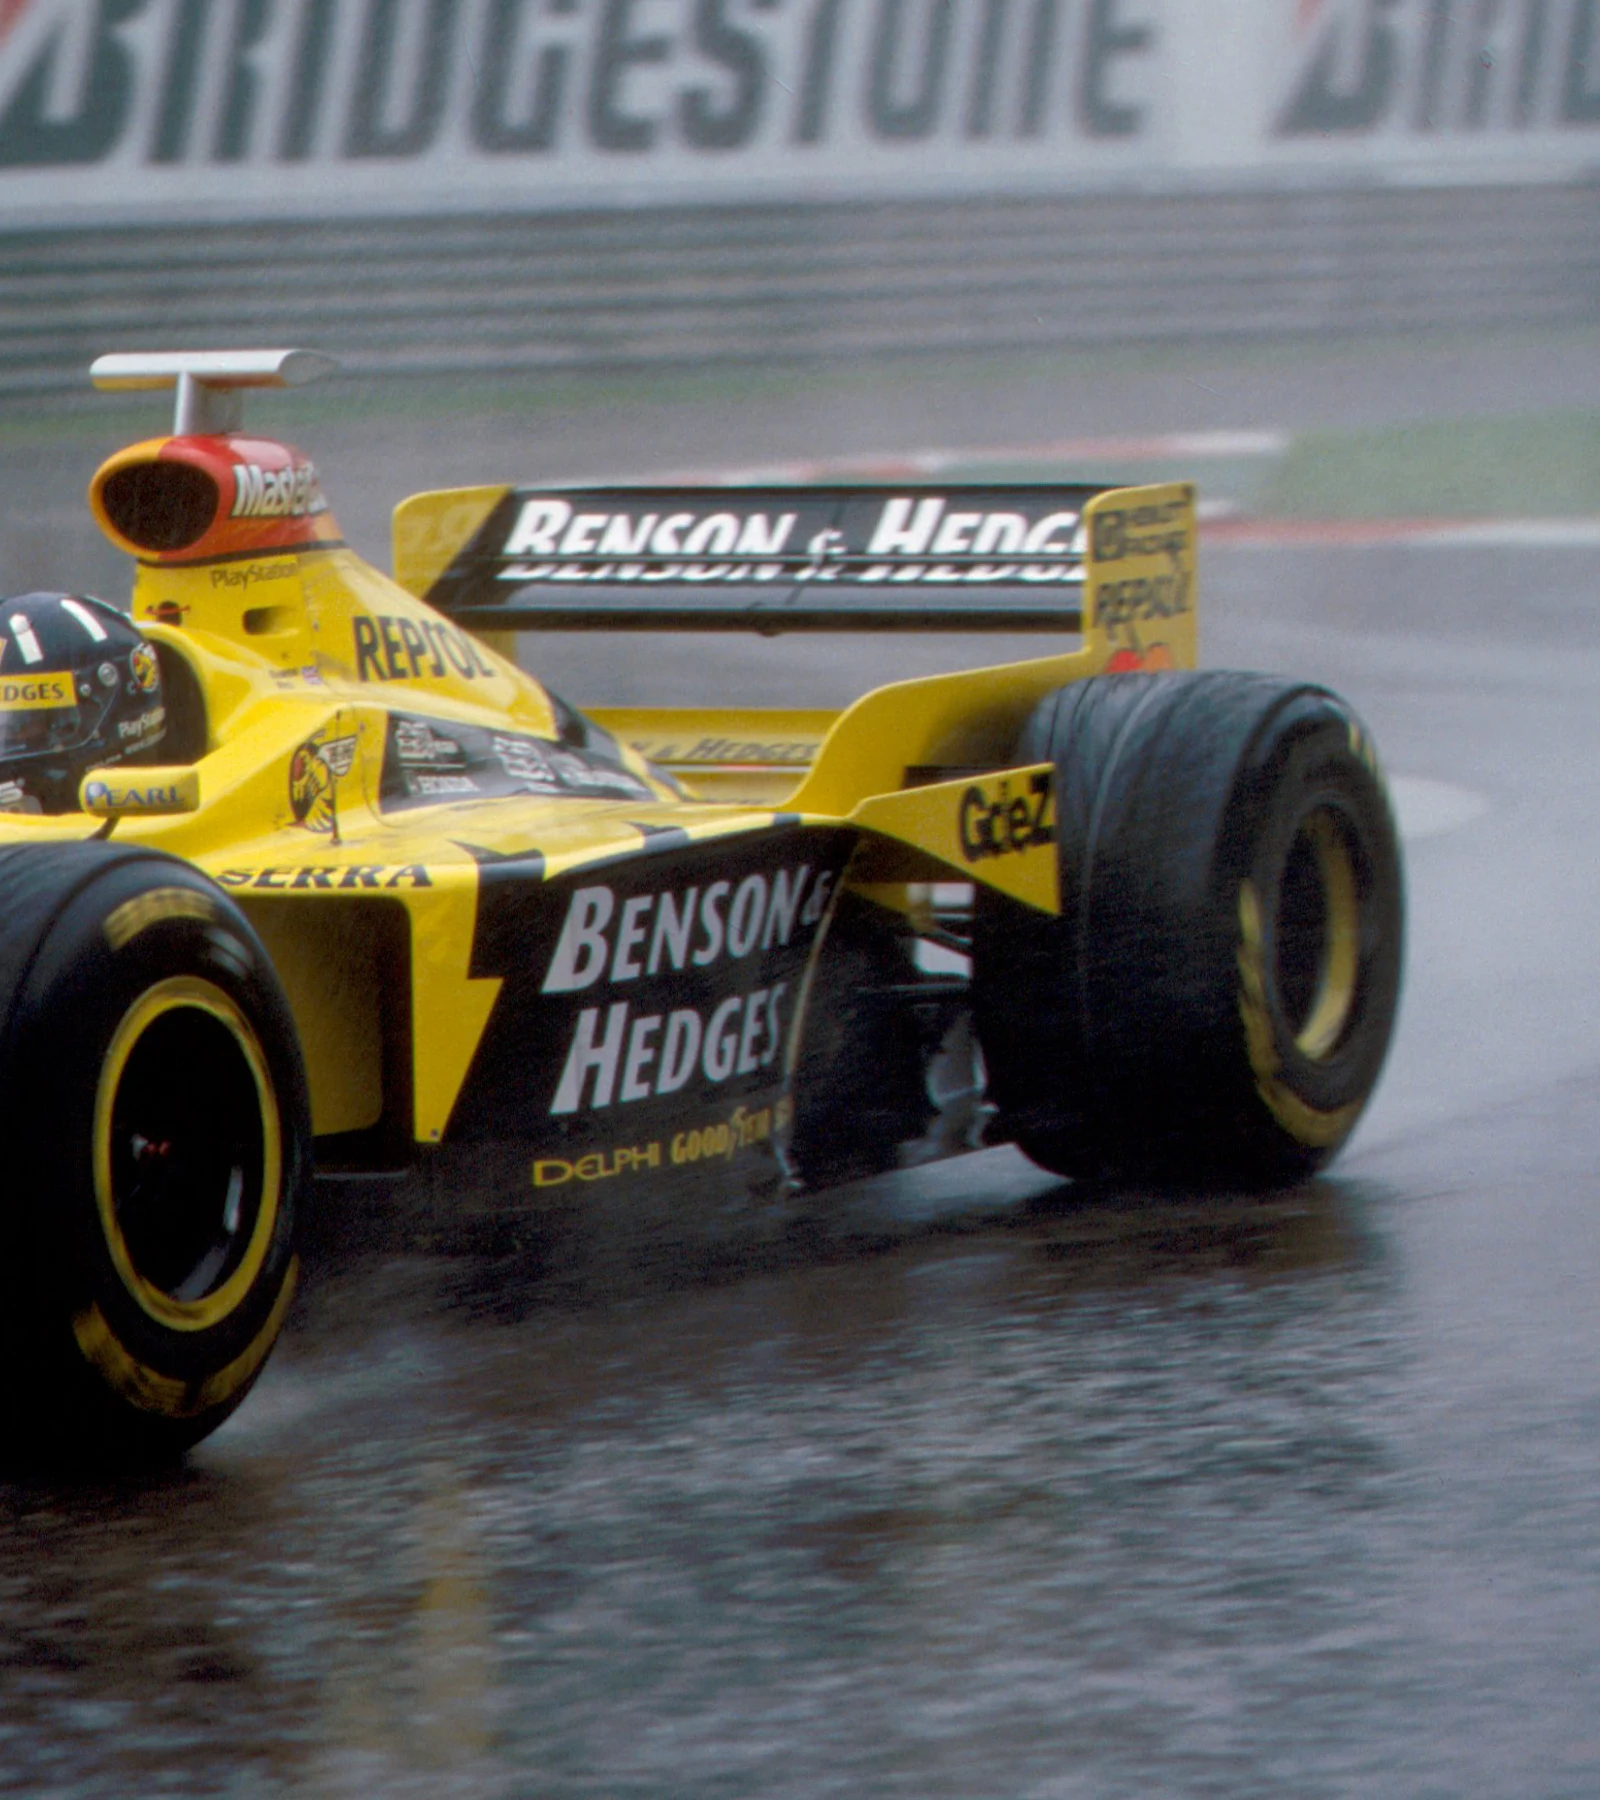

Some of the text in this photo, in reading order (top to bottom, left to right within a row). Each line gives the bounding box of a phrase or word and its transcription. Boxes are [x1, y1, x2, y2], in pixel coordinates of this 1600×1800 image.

[495, 498, 797, 580] BENSON
[352, 615, 495, 683] REPSOL
[84, 781, 186, 808] PEARL
[215, 863, 434, 888] SERRA
[540, 864, 811, 993] BENSON
[550, 982, 787, 1116] HEDGES
[531, 1142, 661, 1187] DELPHI
